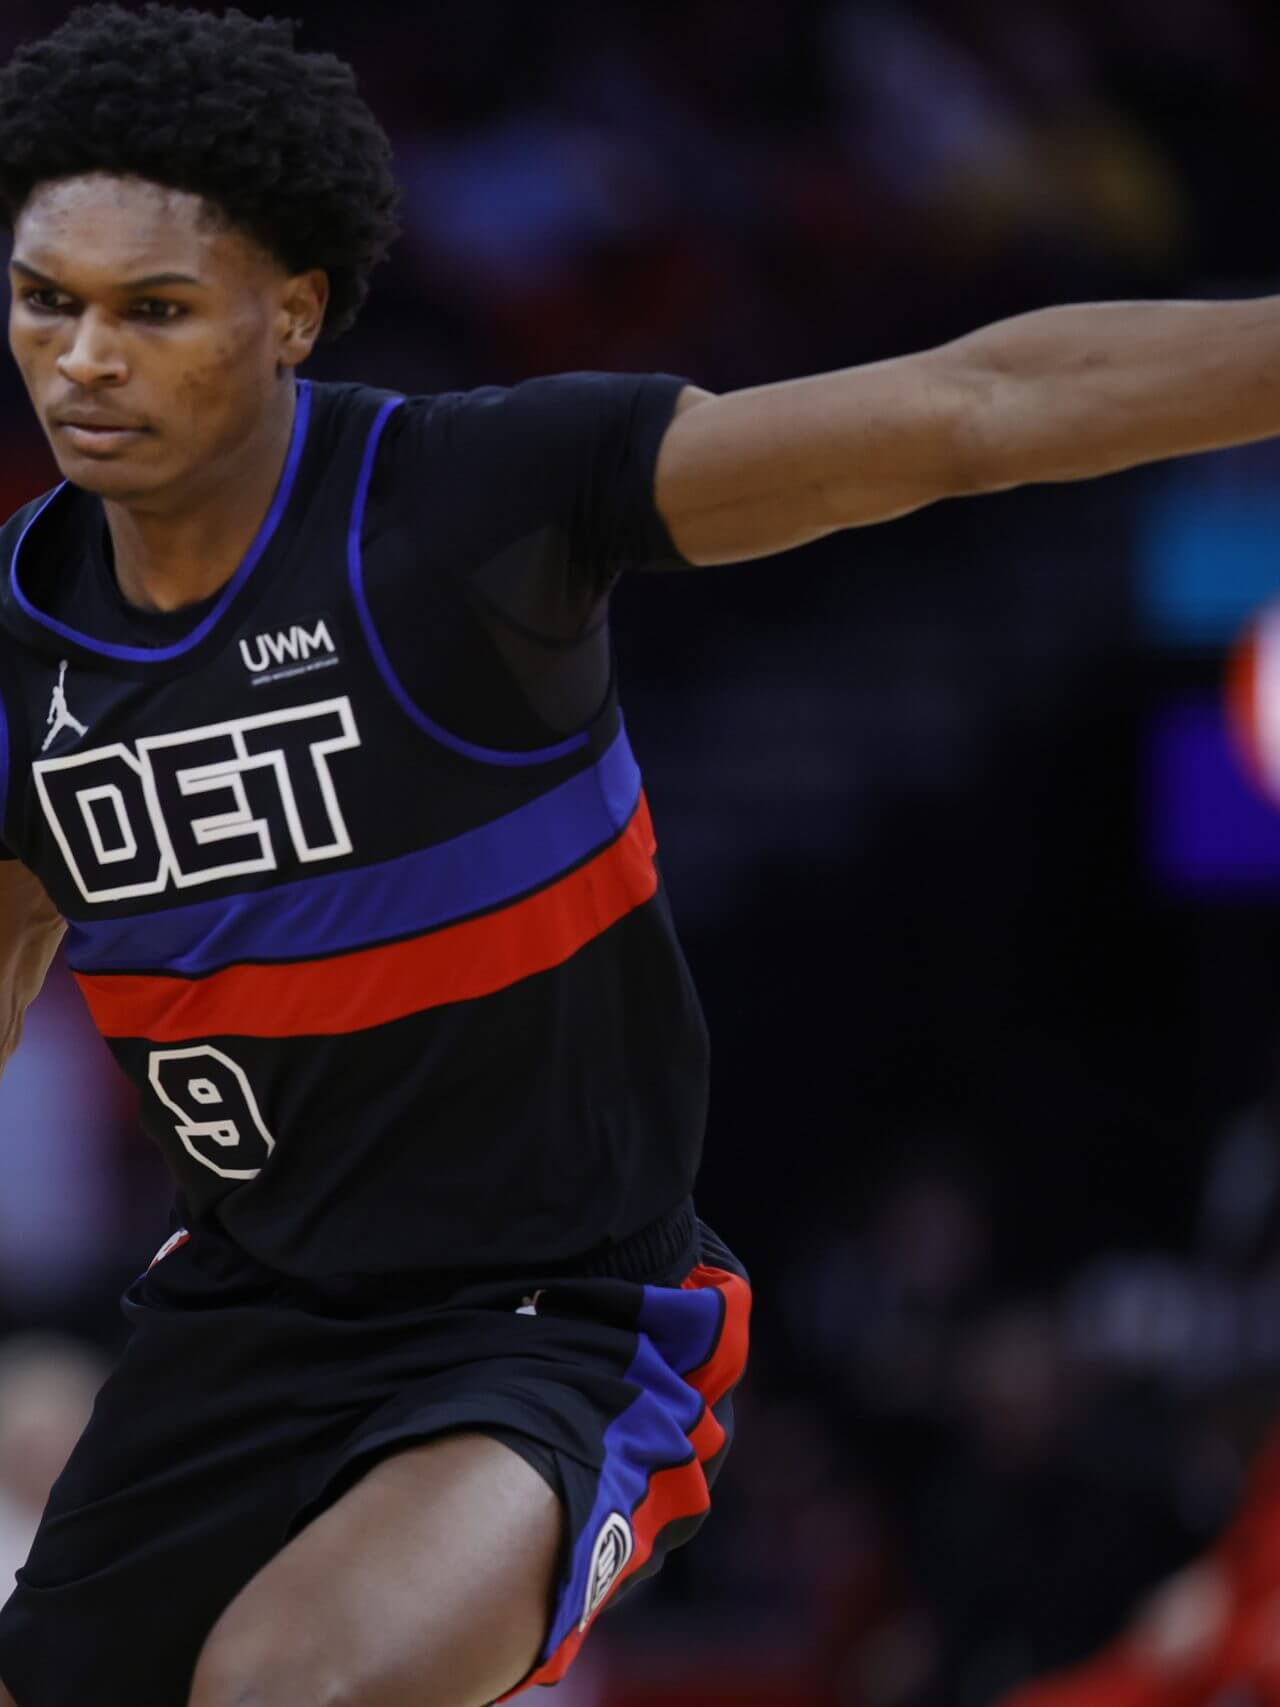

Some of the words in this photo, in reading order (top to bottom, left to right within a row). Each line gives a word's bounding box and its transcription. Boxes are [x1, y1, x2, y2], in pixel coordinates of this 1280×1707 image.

[238, 619, 336, 672] UWM
[32, 695, 361, 903] DET
[148, 1044, 276, 1180] 9
